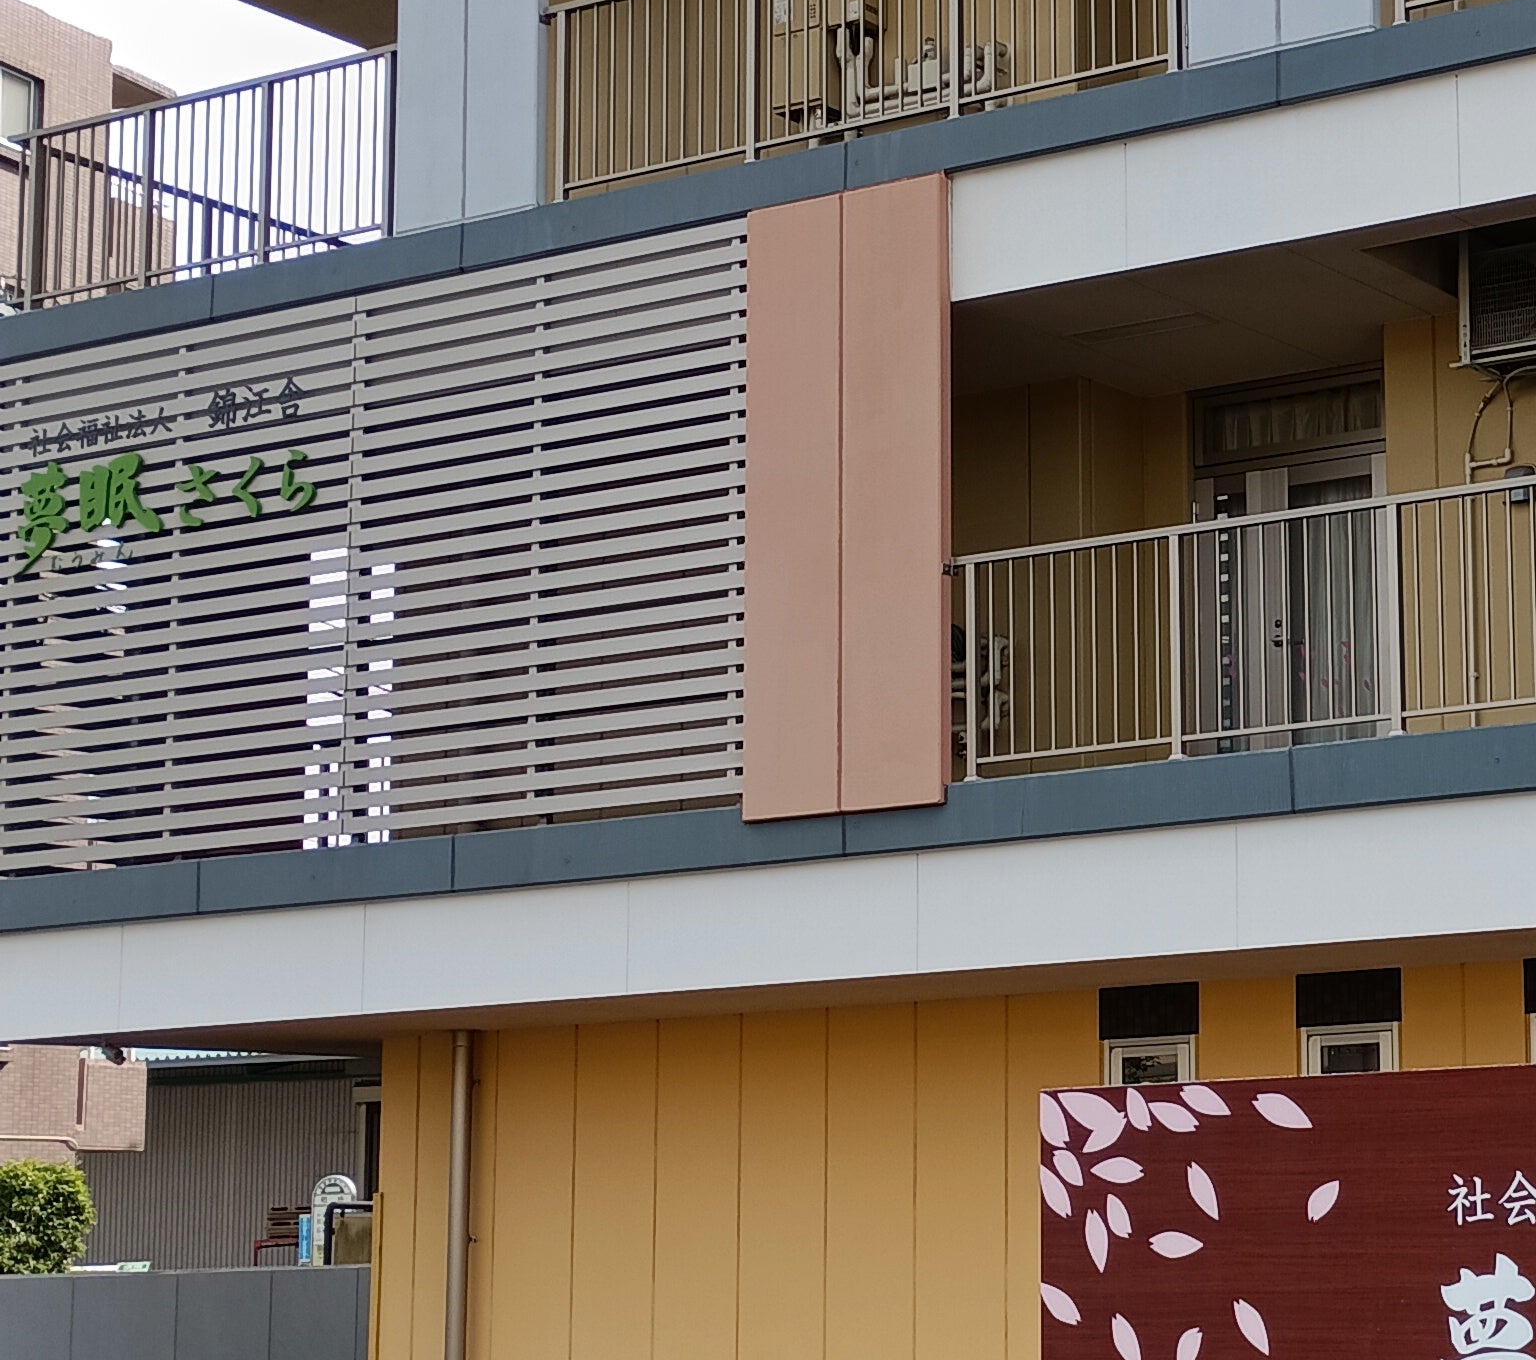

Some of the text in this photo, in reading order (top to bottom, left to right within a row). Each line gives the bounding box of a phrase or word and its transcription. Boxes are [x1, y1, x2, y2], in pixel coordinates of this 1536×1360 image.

[30, 406, 173, 457] 社会福祉法人
